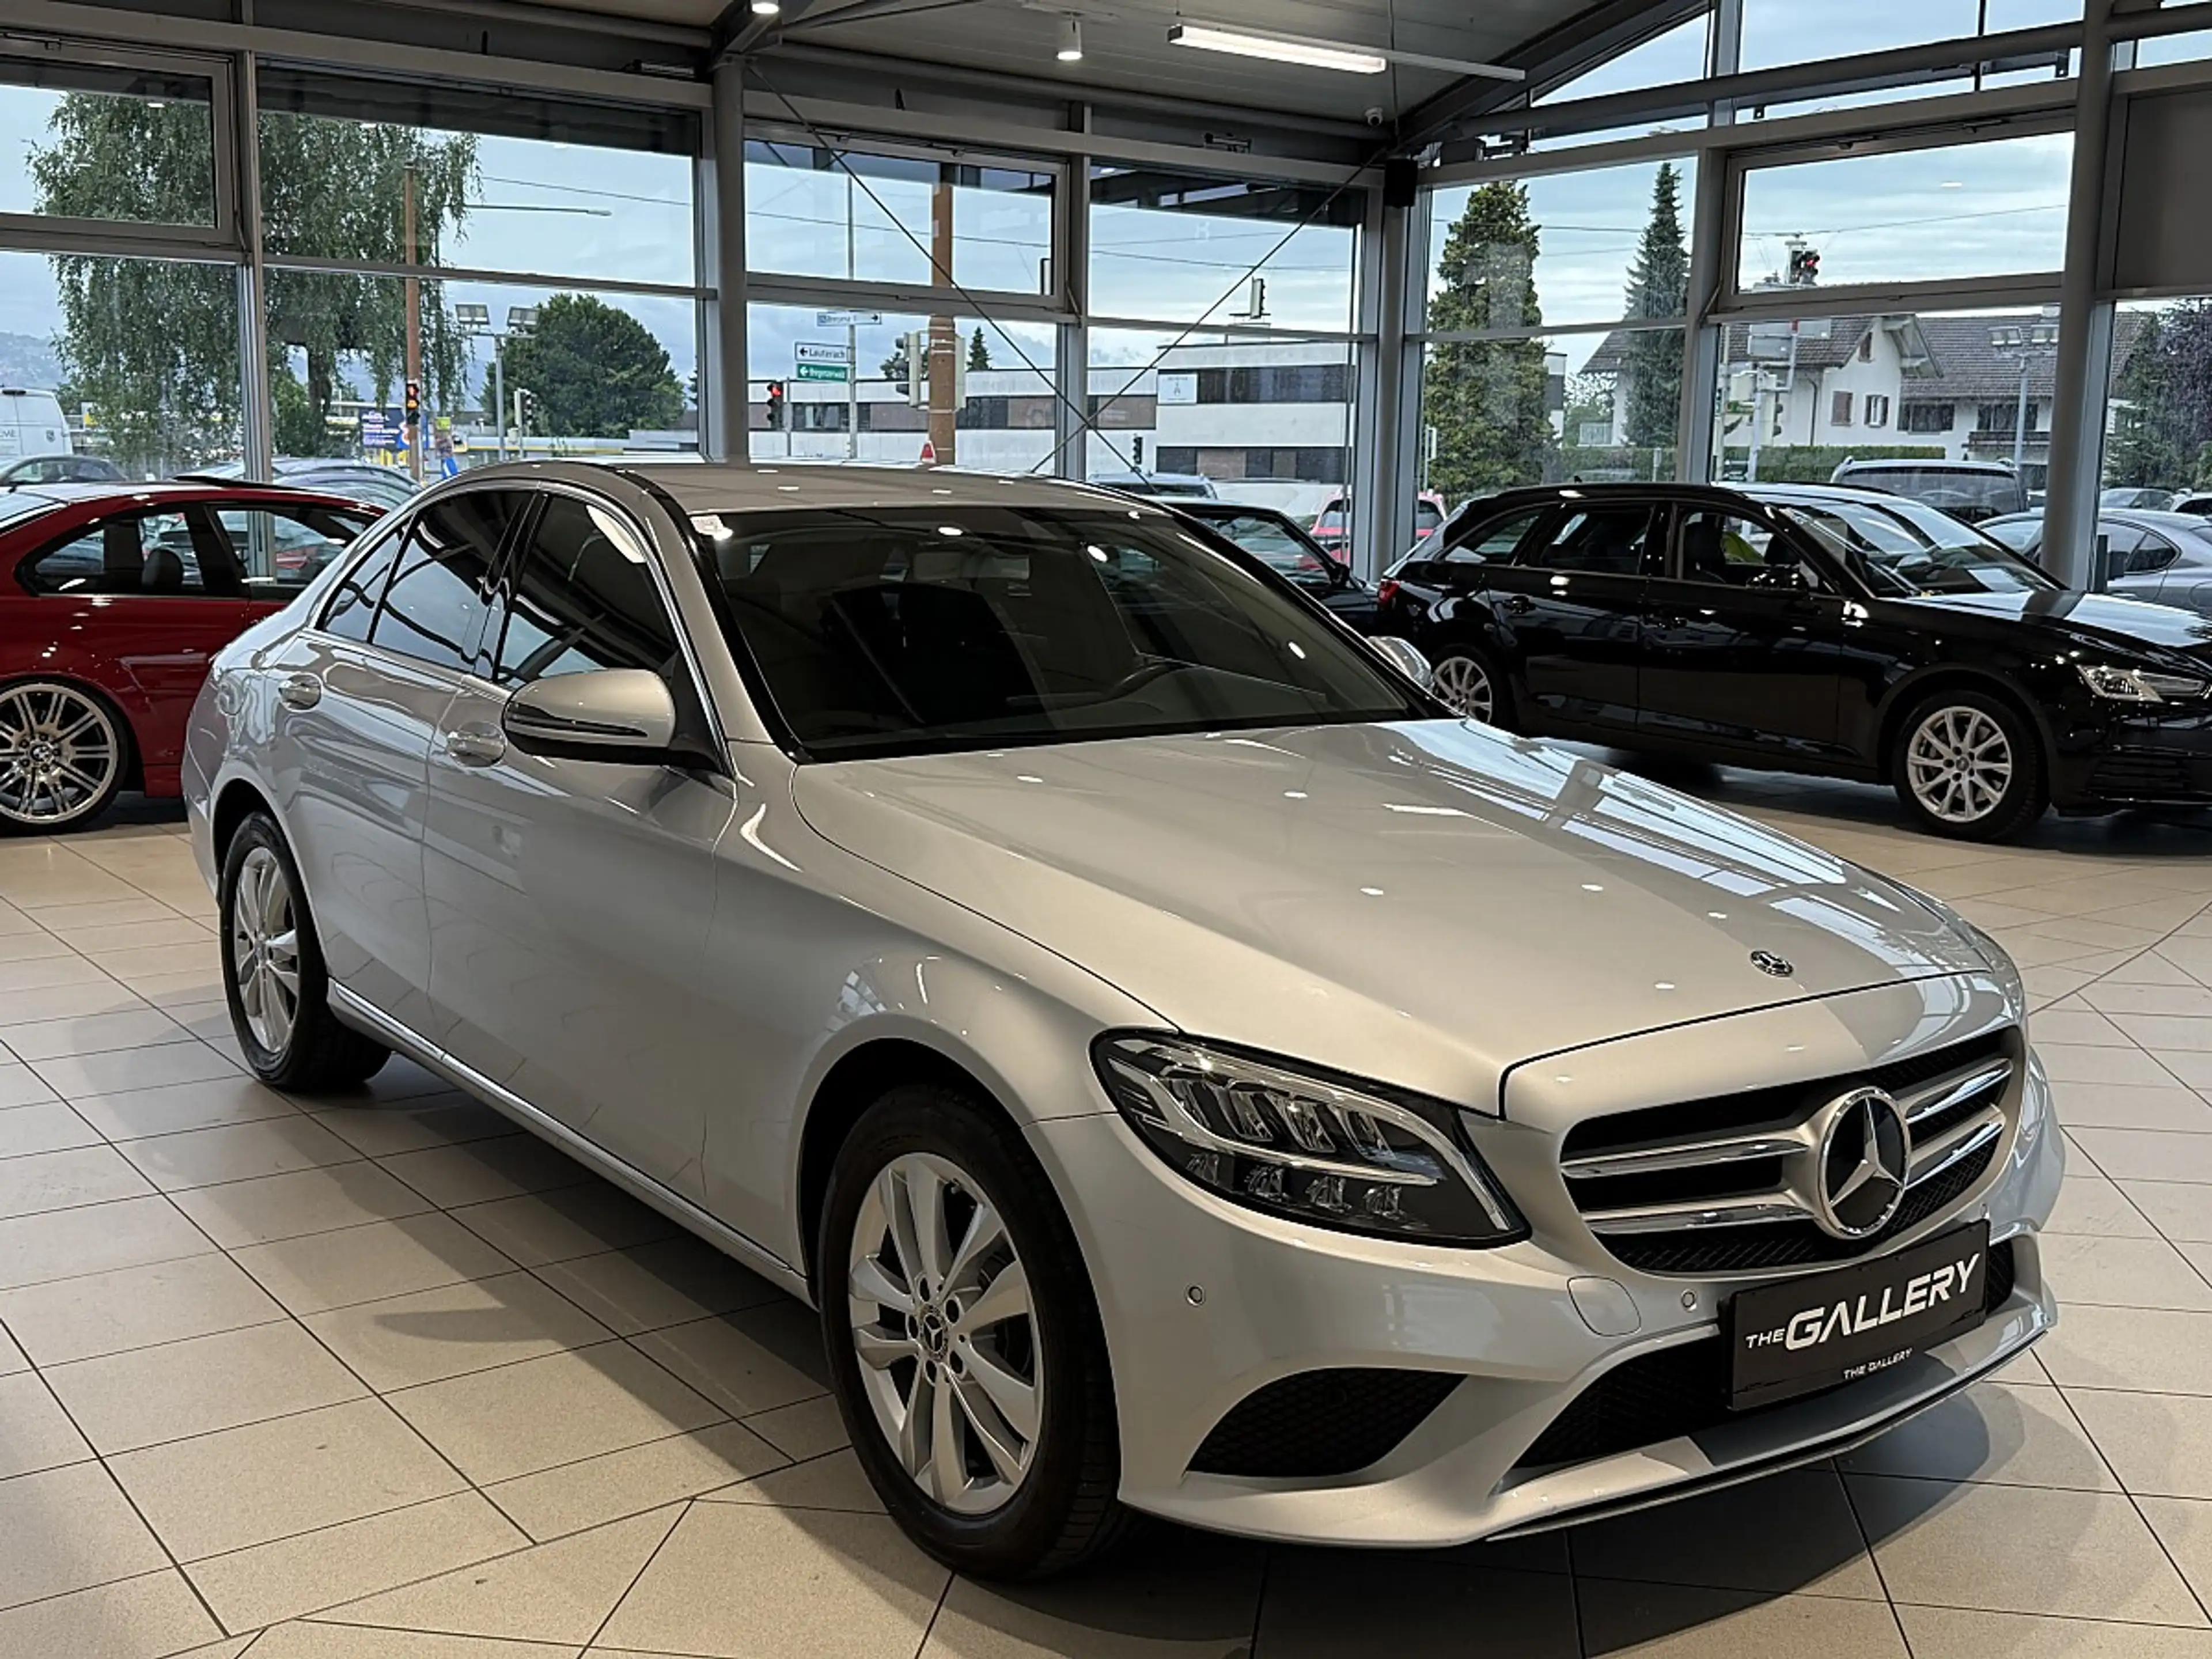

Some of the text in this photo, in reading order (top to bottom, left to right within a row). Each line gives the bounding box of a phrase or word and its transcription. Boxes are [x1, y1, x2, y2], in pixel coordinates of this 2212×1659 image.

[1745, 1252, 1980, 1351] THE GALLERY
[1843, 1347, 1913, 1380] THE GALLERY
